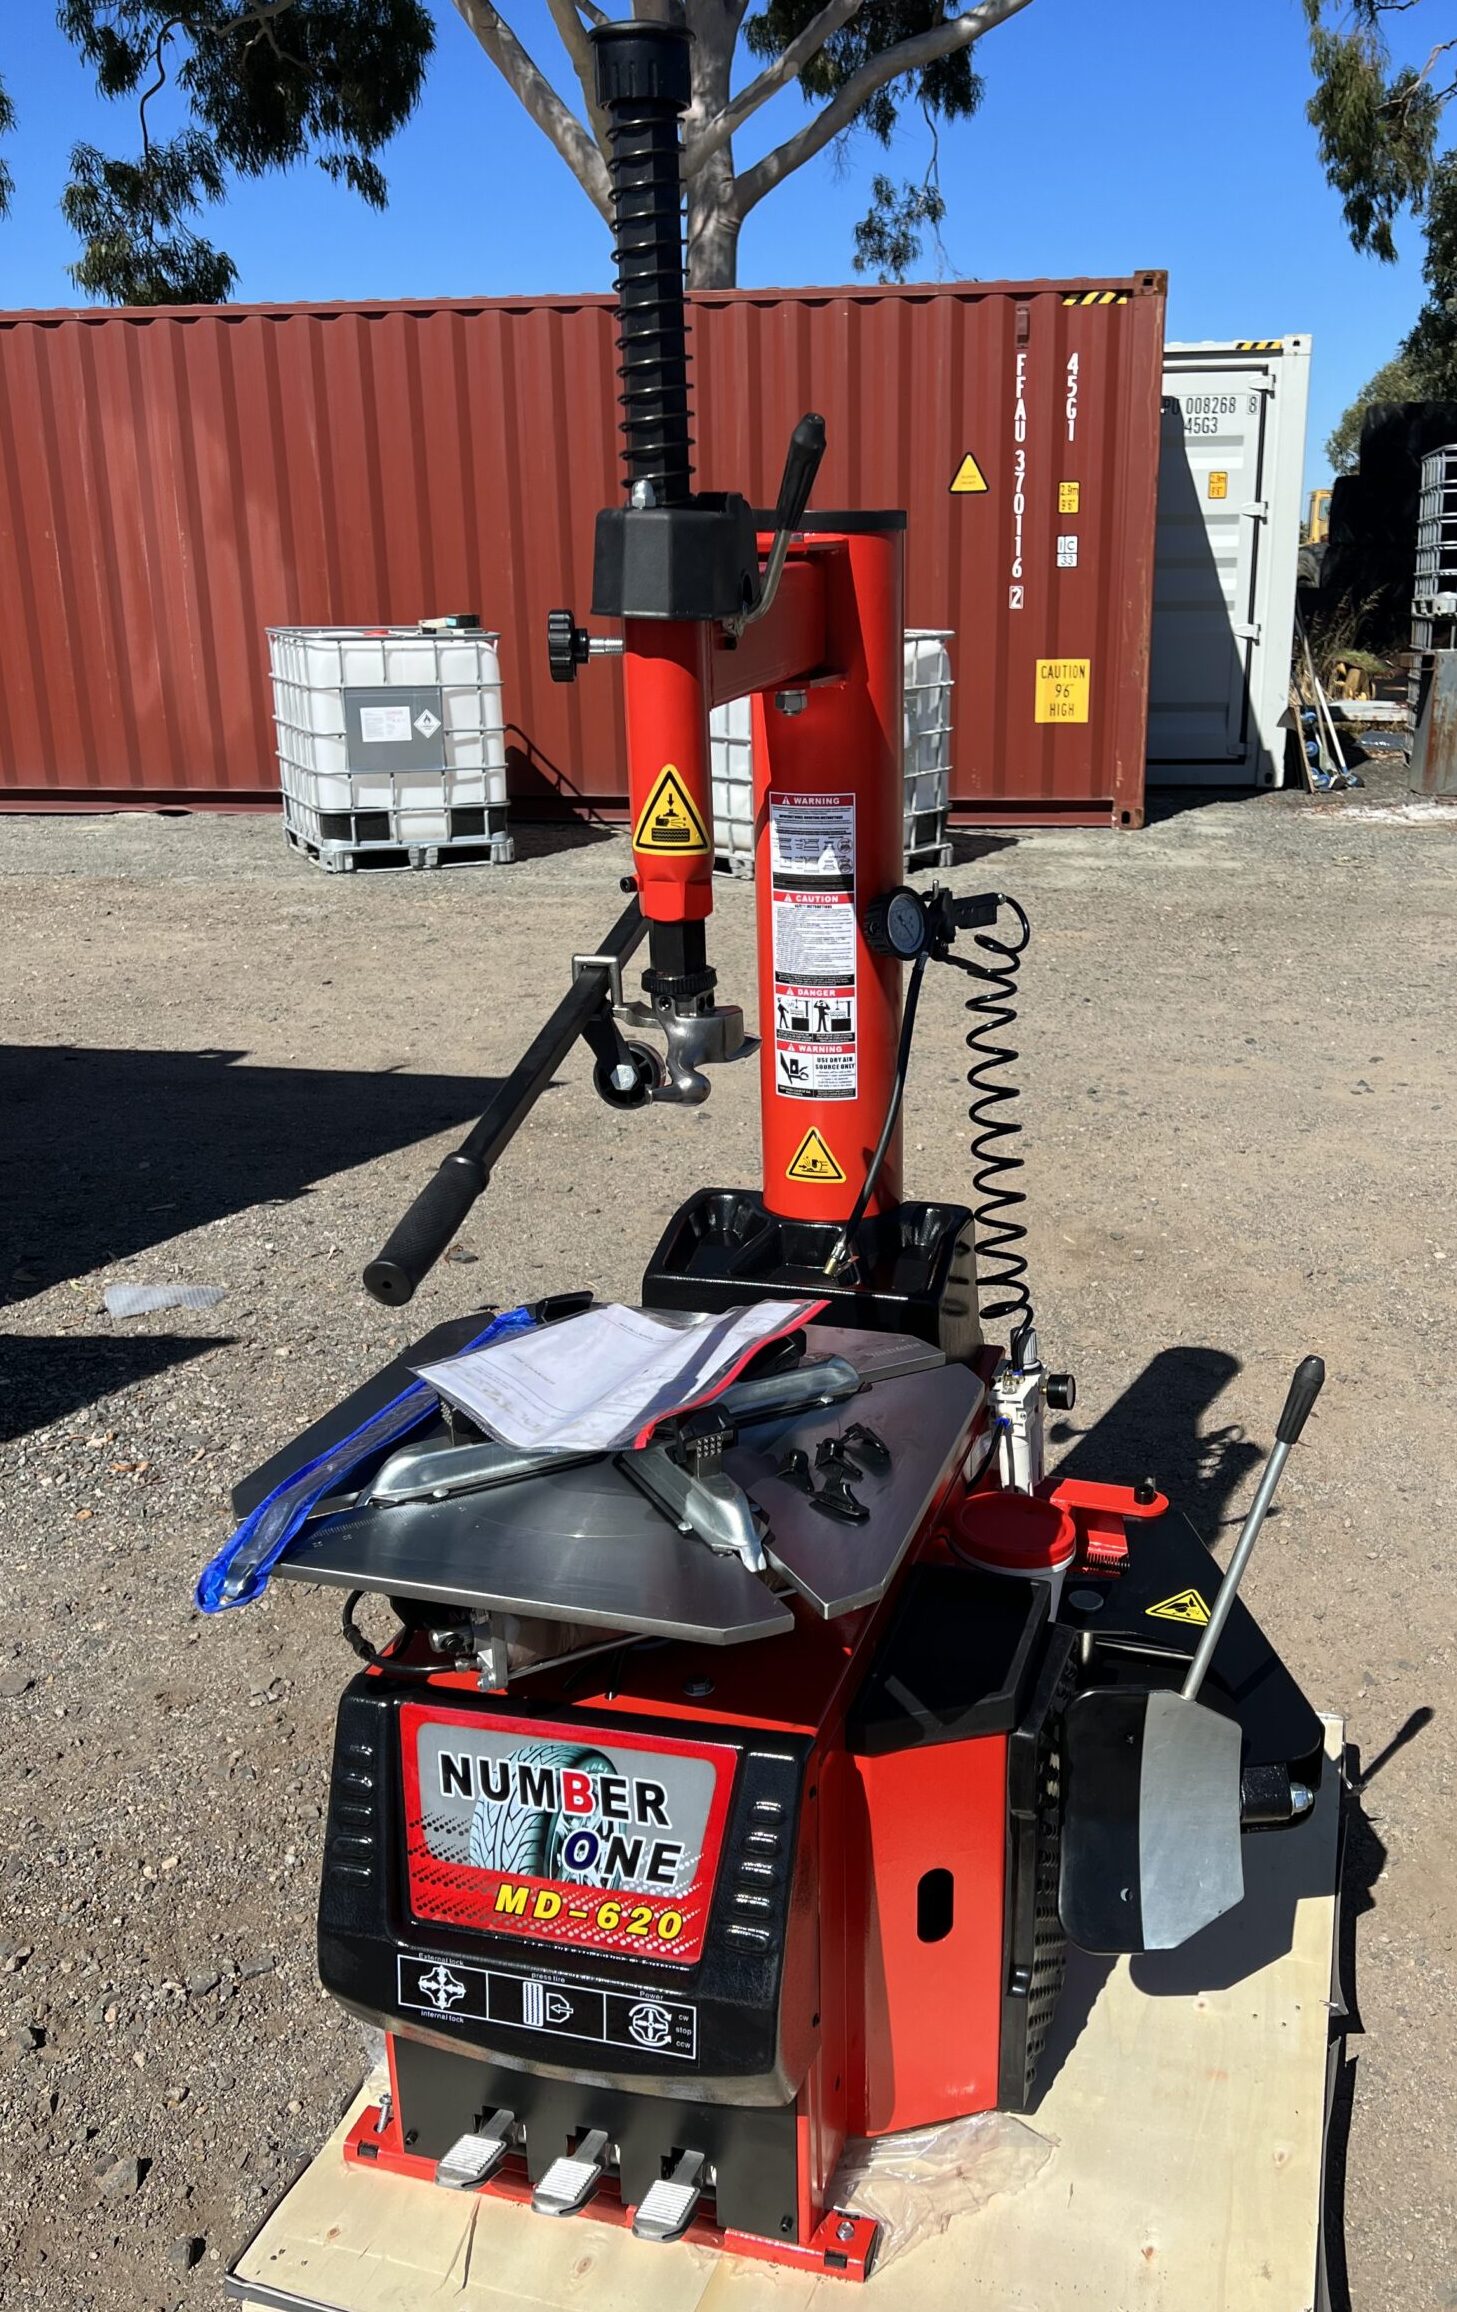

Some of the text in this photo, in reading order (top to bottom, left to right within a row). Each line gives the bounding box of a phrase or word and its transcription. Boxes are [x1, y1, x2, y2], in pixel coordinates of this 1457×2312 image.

[1066, 352, 1079, 442] 45G1
[1185, 397, 1237, 415] 008268
[1249, 396, 1258, 414] 8
[1184, 416, 1218, 435] 45G3
[1010, 353, 1027, 609] FFAU 370116 2
[1041, 665, 1086, 679] CAUTION
[1049, 703, 1075, 717] HIGH
[793, 797, 840, 805] WARNING
[795, 894, 839, 903] CAUTION
[798, 989, 836, 997] DANGER
[798, 1045, 843, 1053] WARNING
[438, 1752, 671, 1828] NUMBER
[563, 1829, 685, 1885] ONE
[494, 1883, 684, 1940] MD-620
[418, 1952, 448, 1965] External
[531, 1972, 566, 1984] press tire
[640, 1990, 664, 2000] Power
[675, 2026, 692, 2036] stop
